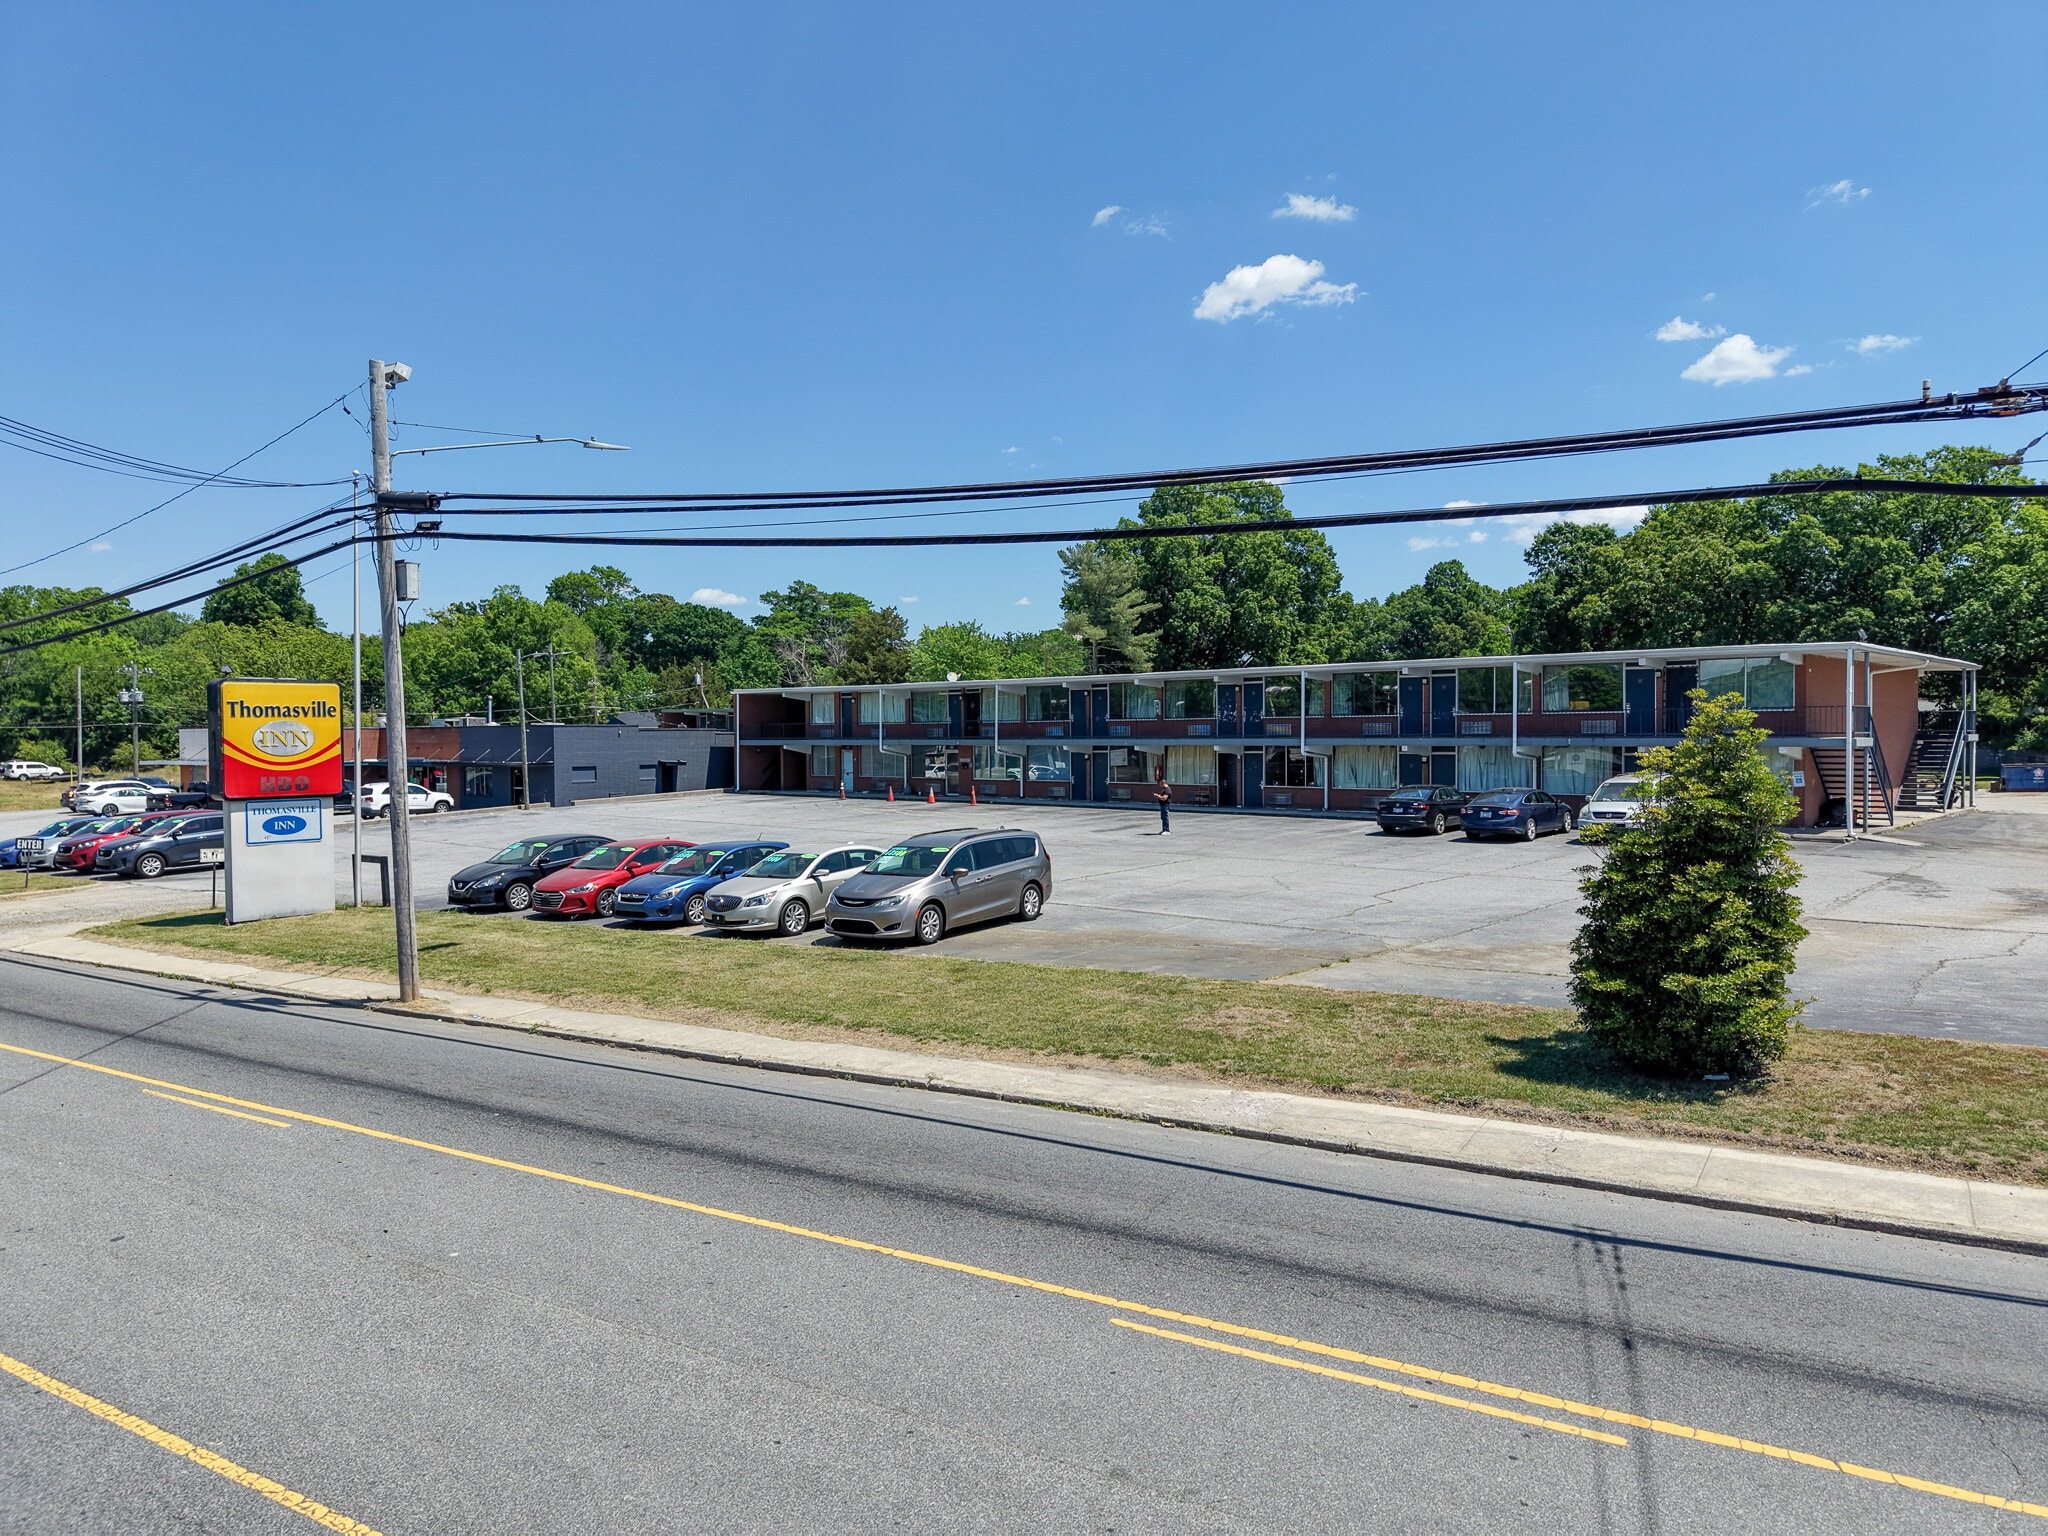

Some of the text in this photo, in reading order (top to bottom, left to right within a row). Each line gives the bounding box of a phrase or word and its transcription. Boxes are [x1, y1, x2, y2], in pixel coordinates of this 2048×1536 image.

[226, 700, 337, 718] Thomasville
[259, 730, 309, 747] INN
[260, 775, 309, 792] HBO
[252, 806, 316, 816] THOMASVILLE
[274, 820, 296, 830] INN
[17, 840, 42, 850] ENTER
